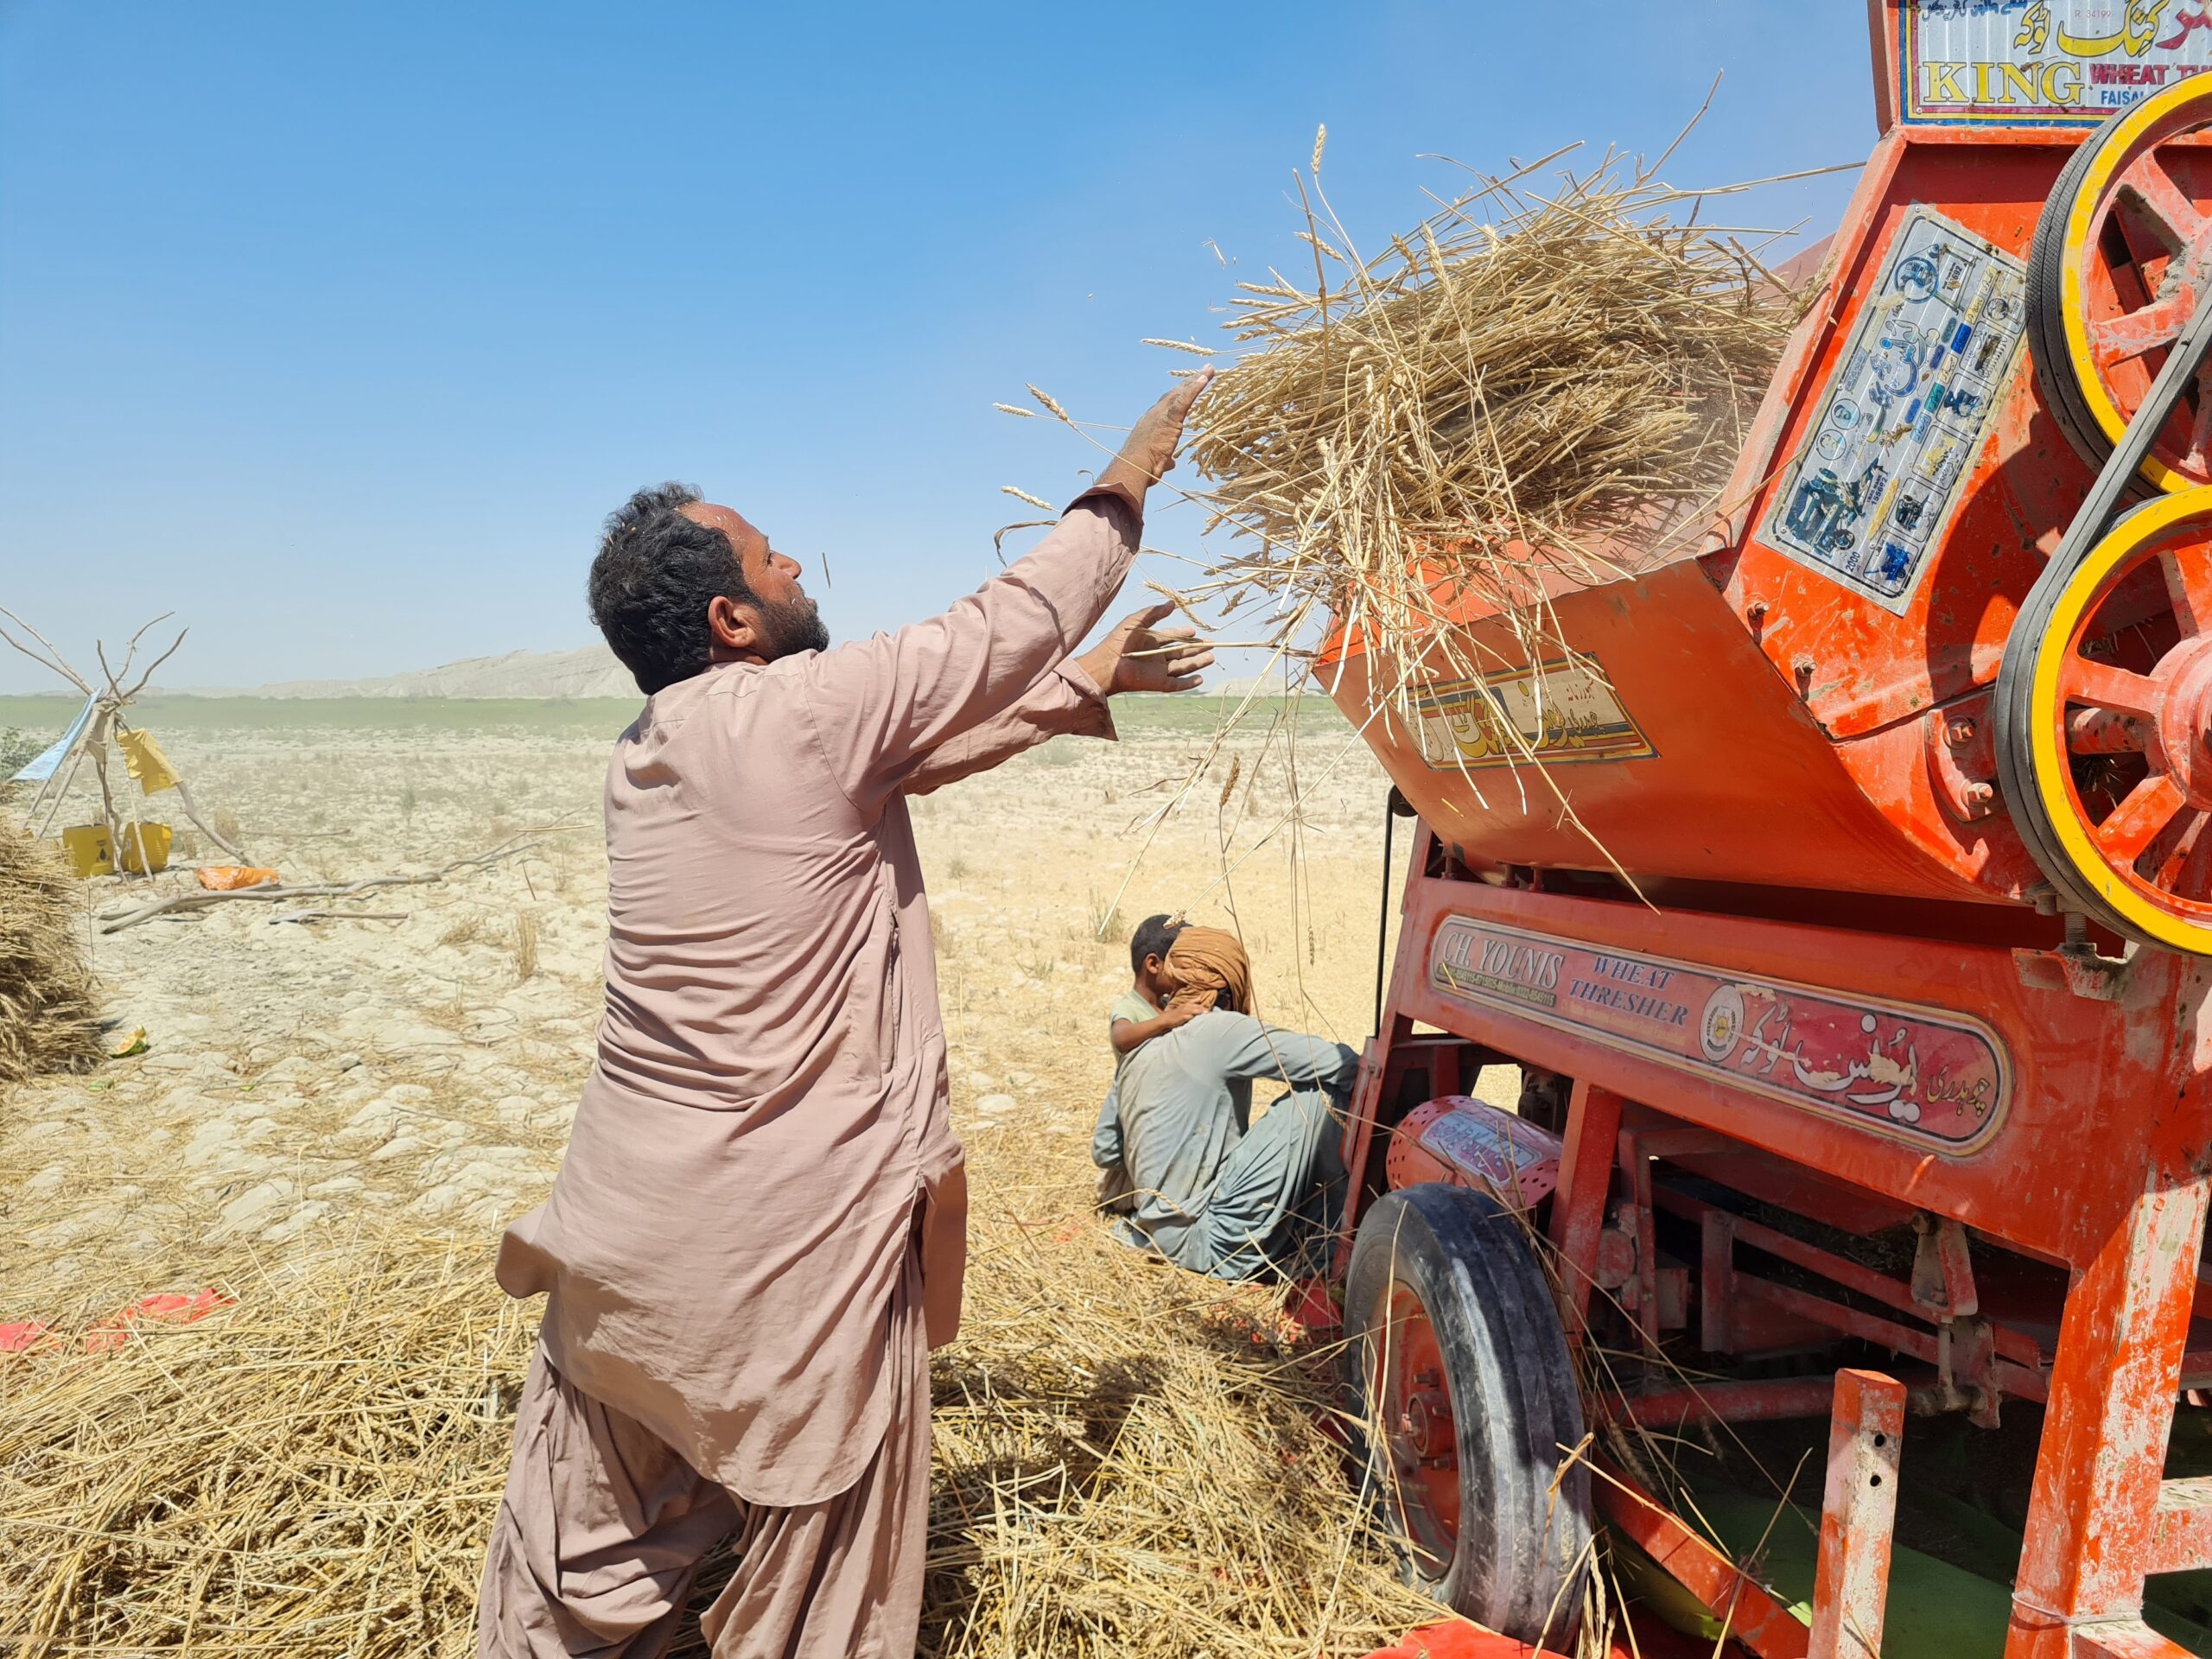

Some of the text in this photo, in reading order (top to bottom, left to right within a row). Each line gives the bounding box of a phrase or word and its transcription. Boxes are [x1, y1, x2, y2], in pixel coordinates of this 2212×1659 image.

[1923, 61, 2085, 105] KING
[2089, 63, 2170, 85] WHEAT
[1870, 475, 1888, 506] 155692
[1844, 550, 1861, 572] 2000
[1478, 938, 1566, 990] YOUNIS
[1593, 955, 1674, 990] WHEAT
[1568, 979, 1688, 1027] THRESHER
